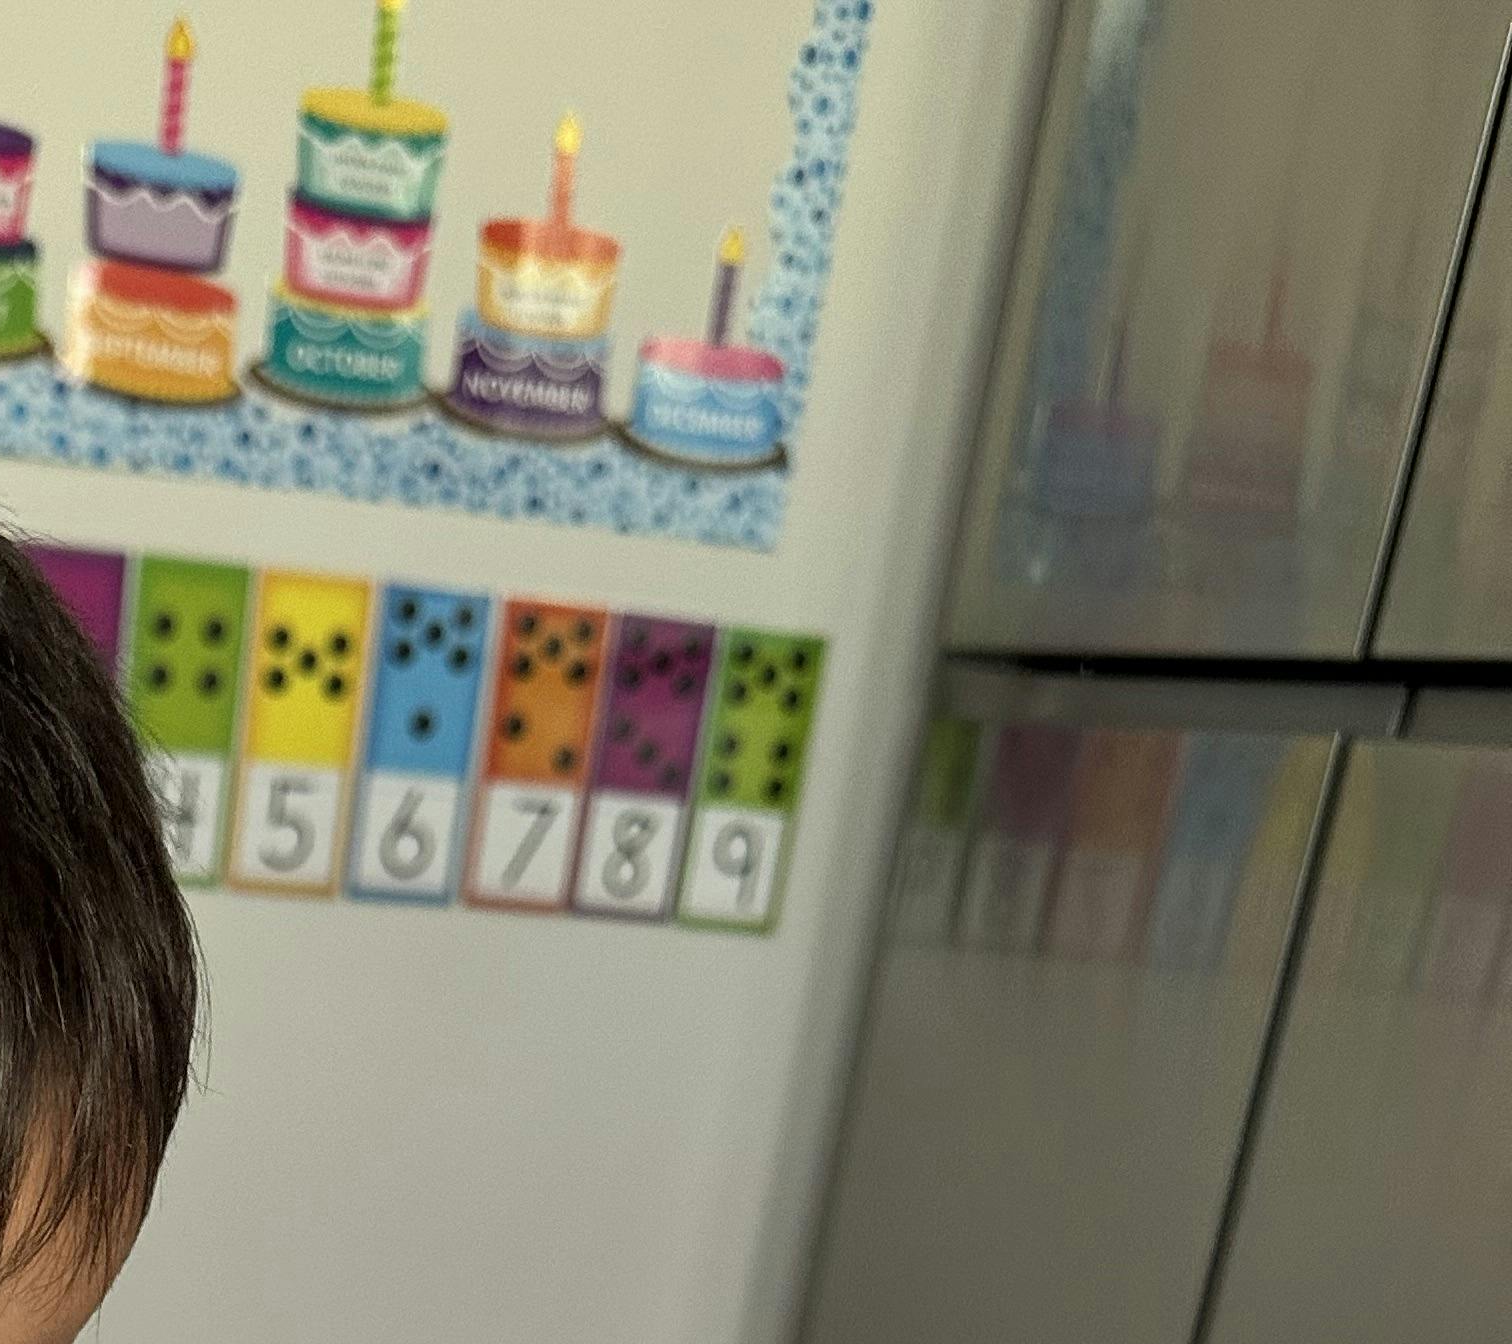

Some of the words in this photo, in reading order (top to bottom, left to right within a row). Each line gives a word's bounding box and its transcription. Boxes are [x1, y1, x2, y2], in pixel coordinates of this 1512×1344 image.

[286, 343, 405, 381] OCTOBER
[463, 371, 592, 415] NOVEMBER
[257, 774, 319, 873] 5
[378, 786, 438, 880] 6
[500, 797, 559, 889] 7
[601, 807, 659, 899] 8
[711, 819, 767, 908] 9
